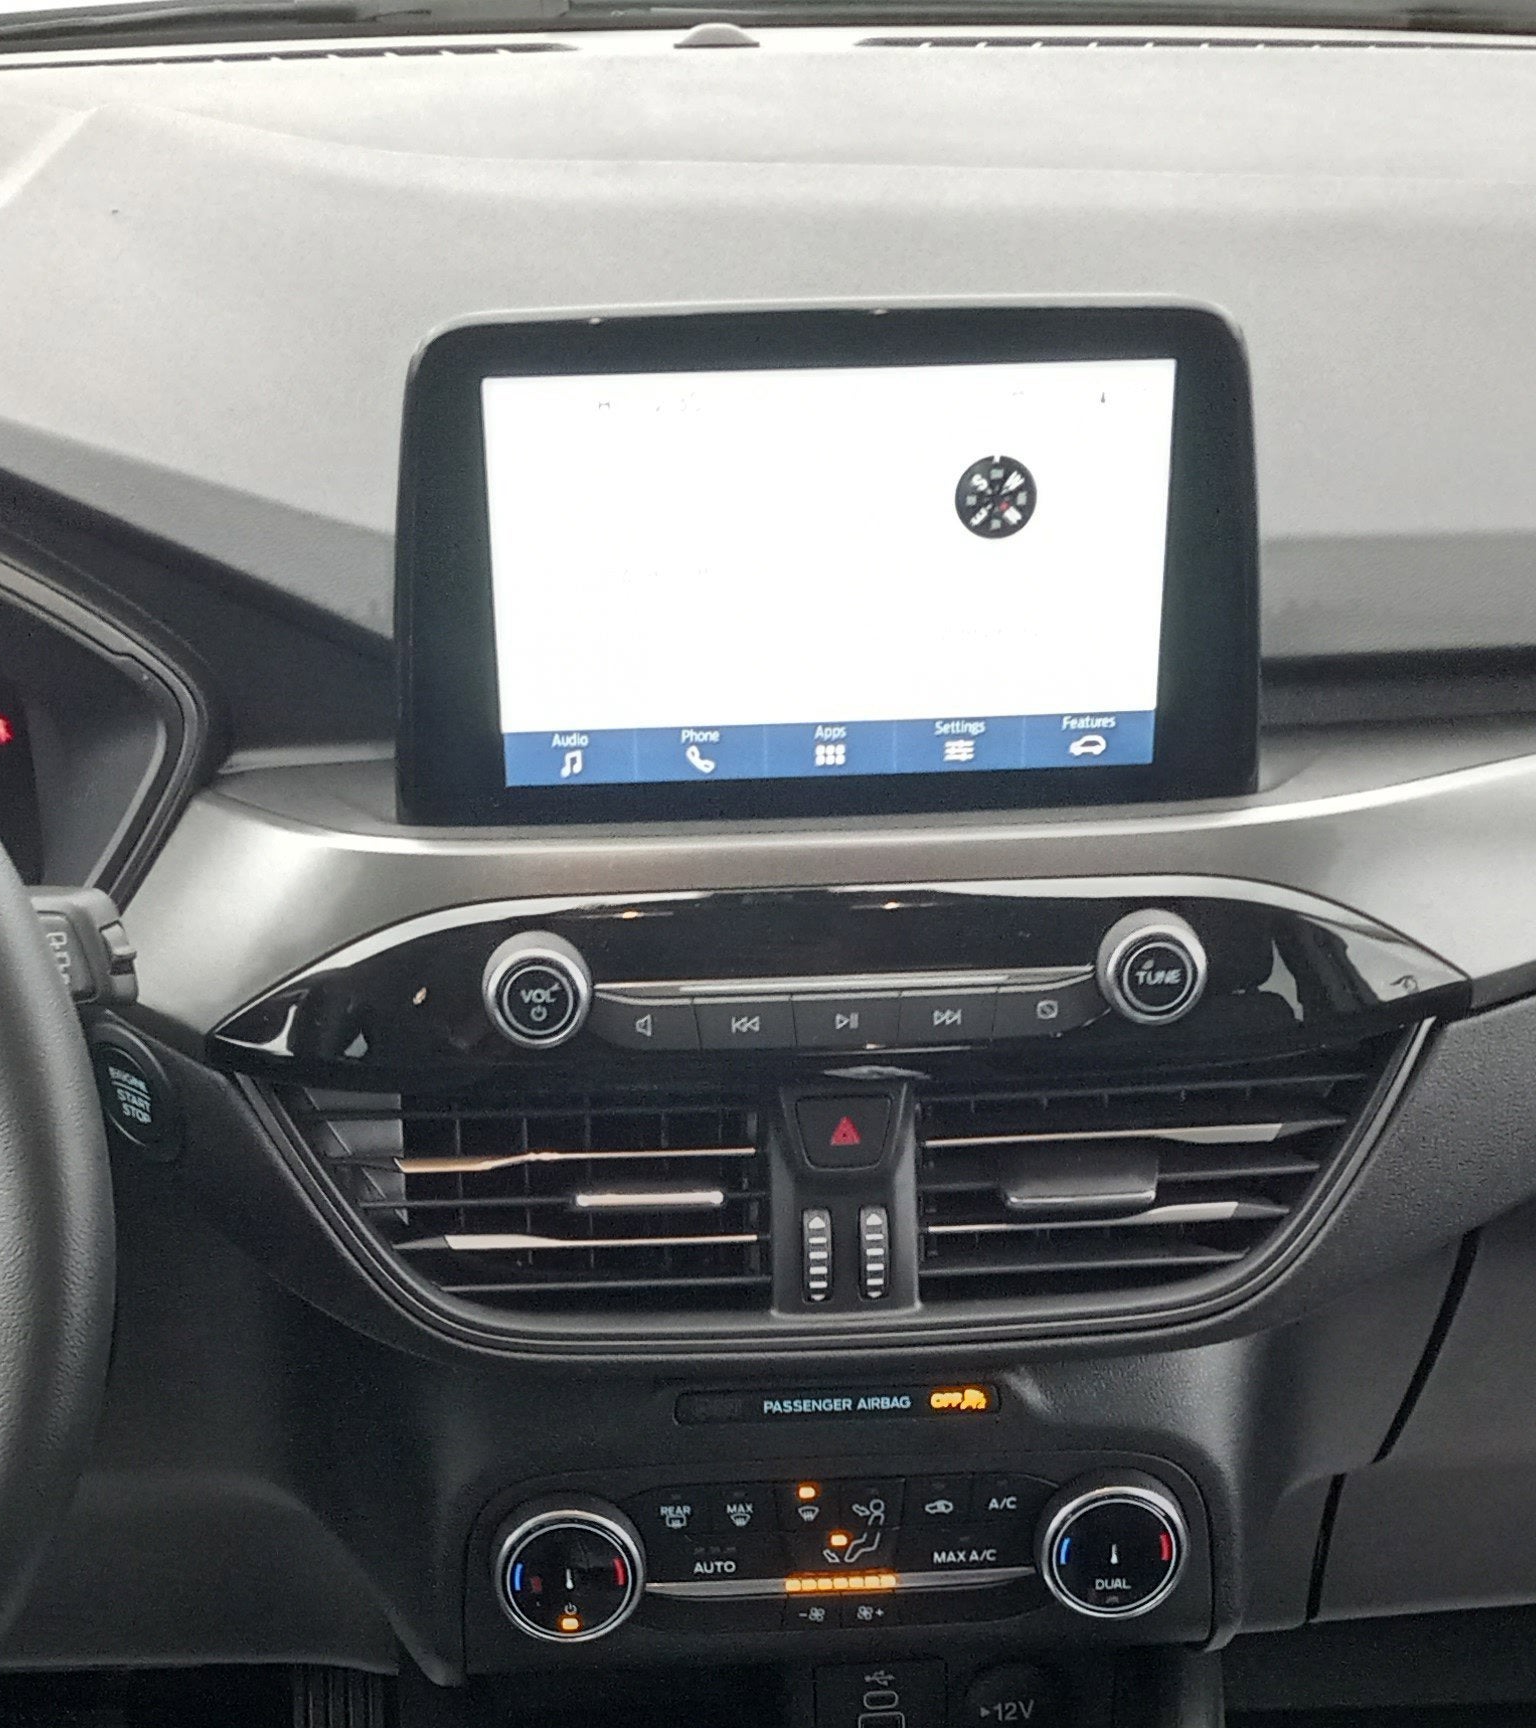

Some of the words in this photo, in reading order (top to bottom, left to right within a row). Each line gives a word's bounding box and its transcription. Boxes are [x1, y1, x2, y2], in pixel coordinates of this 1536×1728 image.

[934, 720, 986, 737] Settings
[1061, 715, 1116, 731] Features
[551, 733, 589, 749] Audio
[680, 728, 721, 744] Phone
[814, 725, 847, 742] Apps
[1134, 968, 1182, 986] TUNE
[520, 988, 557, 1004] VOL
[117, 1088, 151, 1113] START
[122, 1102, 152, 1123] STOP
[763, 1398, 853, 1415] PASSENGER
[856, 1395, 912, 1412] AIRBAG
[660, 1504, 692, 1517] REAR
[726, 1503, 754, 1514] MAX
[988, 1496, 1017, 1511] A/C
[933, 1551, 966, 1564] MAX
[969, 1549, 998, 1562] A/C
[693, 1560, 737, 1574] AUTO
[1095, 1577, 1131, 1591] DUAL
[993, 1699, 1035, 1721] 12V
